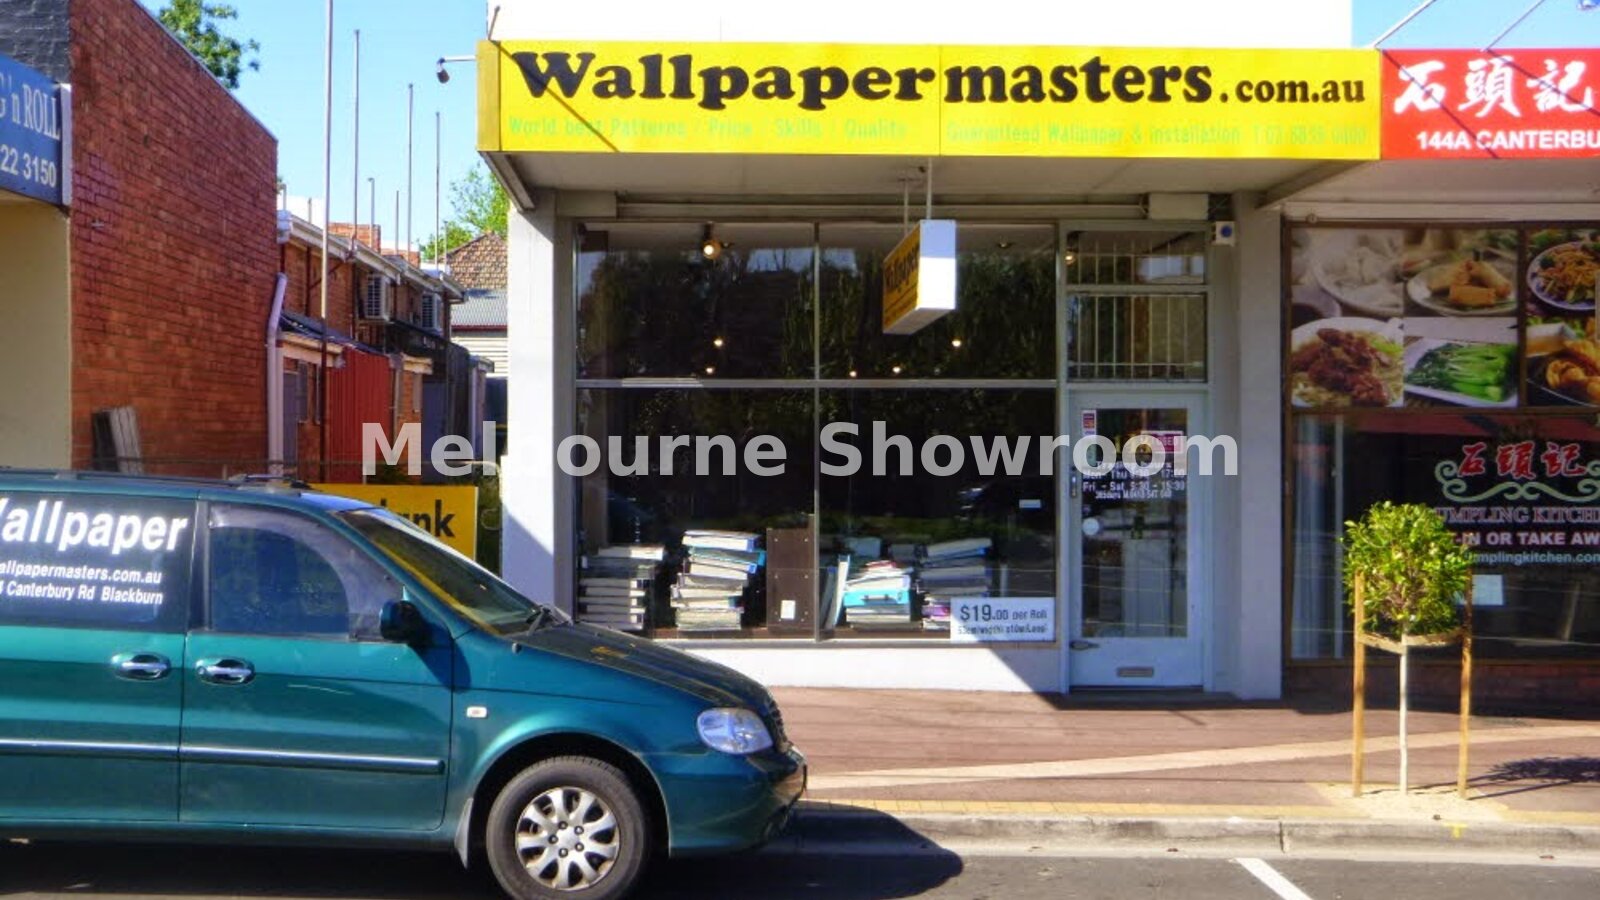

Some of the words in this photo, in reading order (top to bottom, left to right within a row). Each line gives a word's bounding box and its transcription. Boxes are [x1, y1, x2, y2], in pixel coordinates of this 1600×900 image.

[22, 83, 60, 141] ROLL
[509, 117, 557, 136] World
[1416, 130, 1471, 149] 144A
[1476, 129, 1600, 149] CANTERBU
[22, 152, 58, 188] 3150
[1434, 506, 1530, 524] UMPLING
[1486, 531, 1513, 545] OR
[1517, 531, 1566, 545] TAKE
[7, 580, 74, 602] Canterbury
[78, 584, 95, 601] Rd
[101, 585, 164, 605] Blackburn
[960, 603, 1009, 622] $19.00
